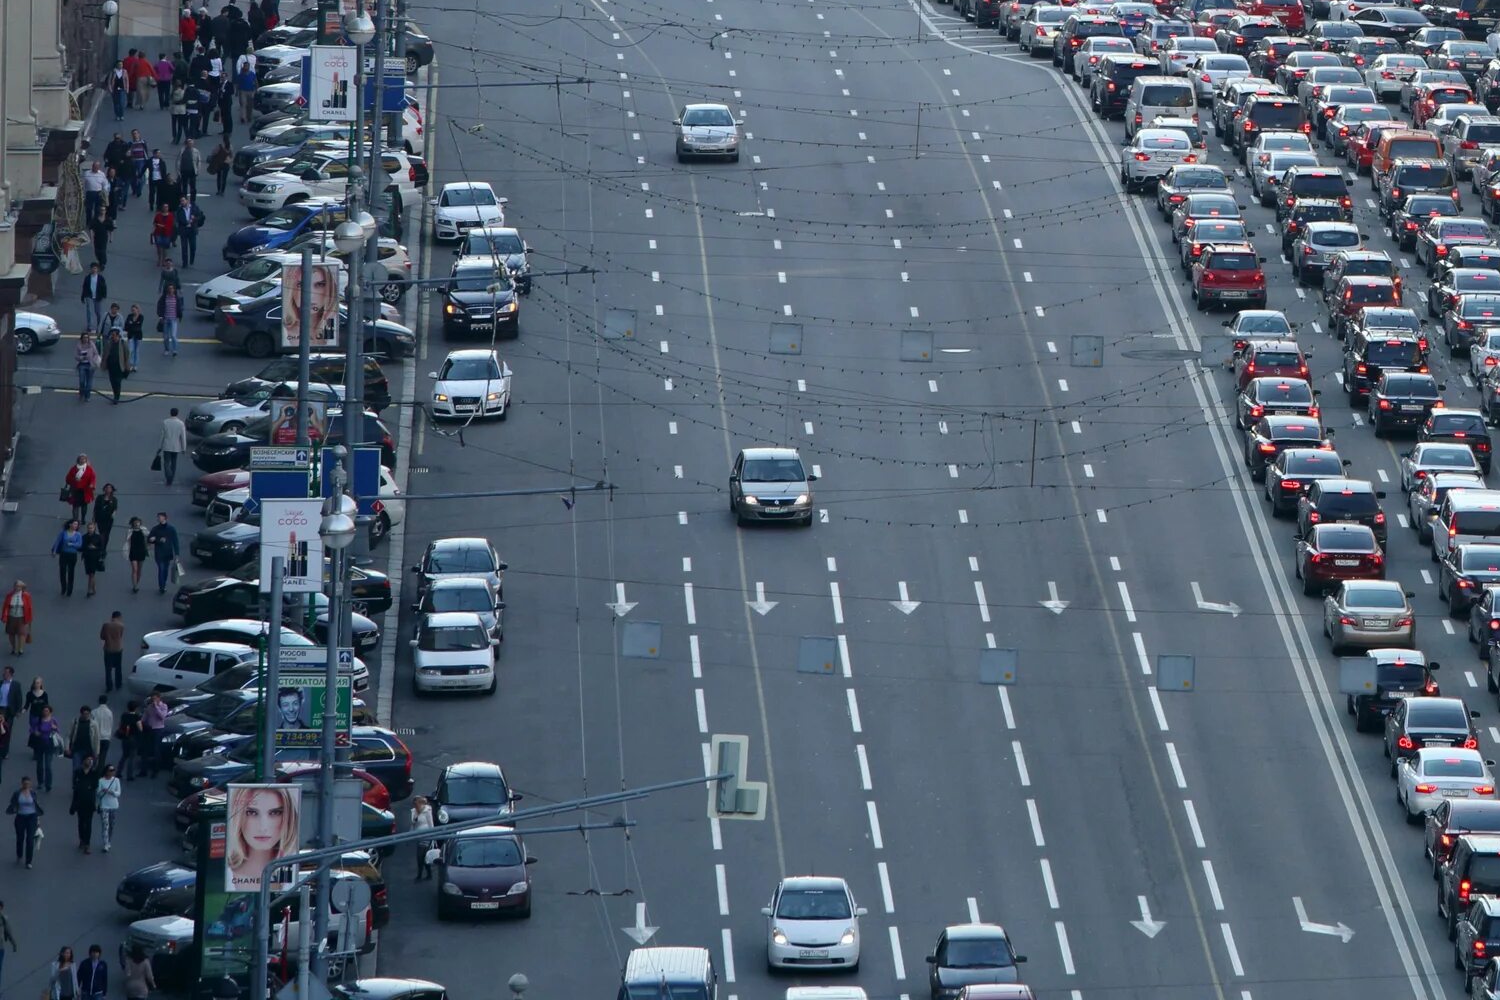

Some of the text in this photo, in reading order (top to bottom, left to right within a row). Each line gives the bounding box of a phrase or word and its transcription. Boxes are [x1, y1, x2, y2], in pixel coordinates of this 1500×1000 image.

[278, 517, 308, 526] COCO
[278, 678, 349, 687] СТОМАТОЛИЯ
[231, 877, 262, 885] CHANE
